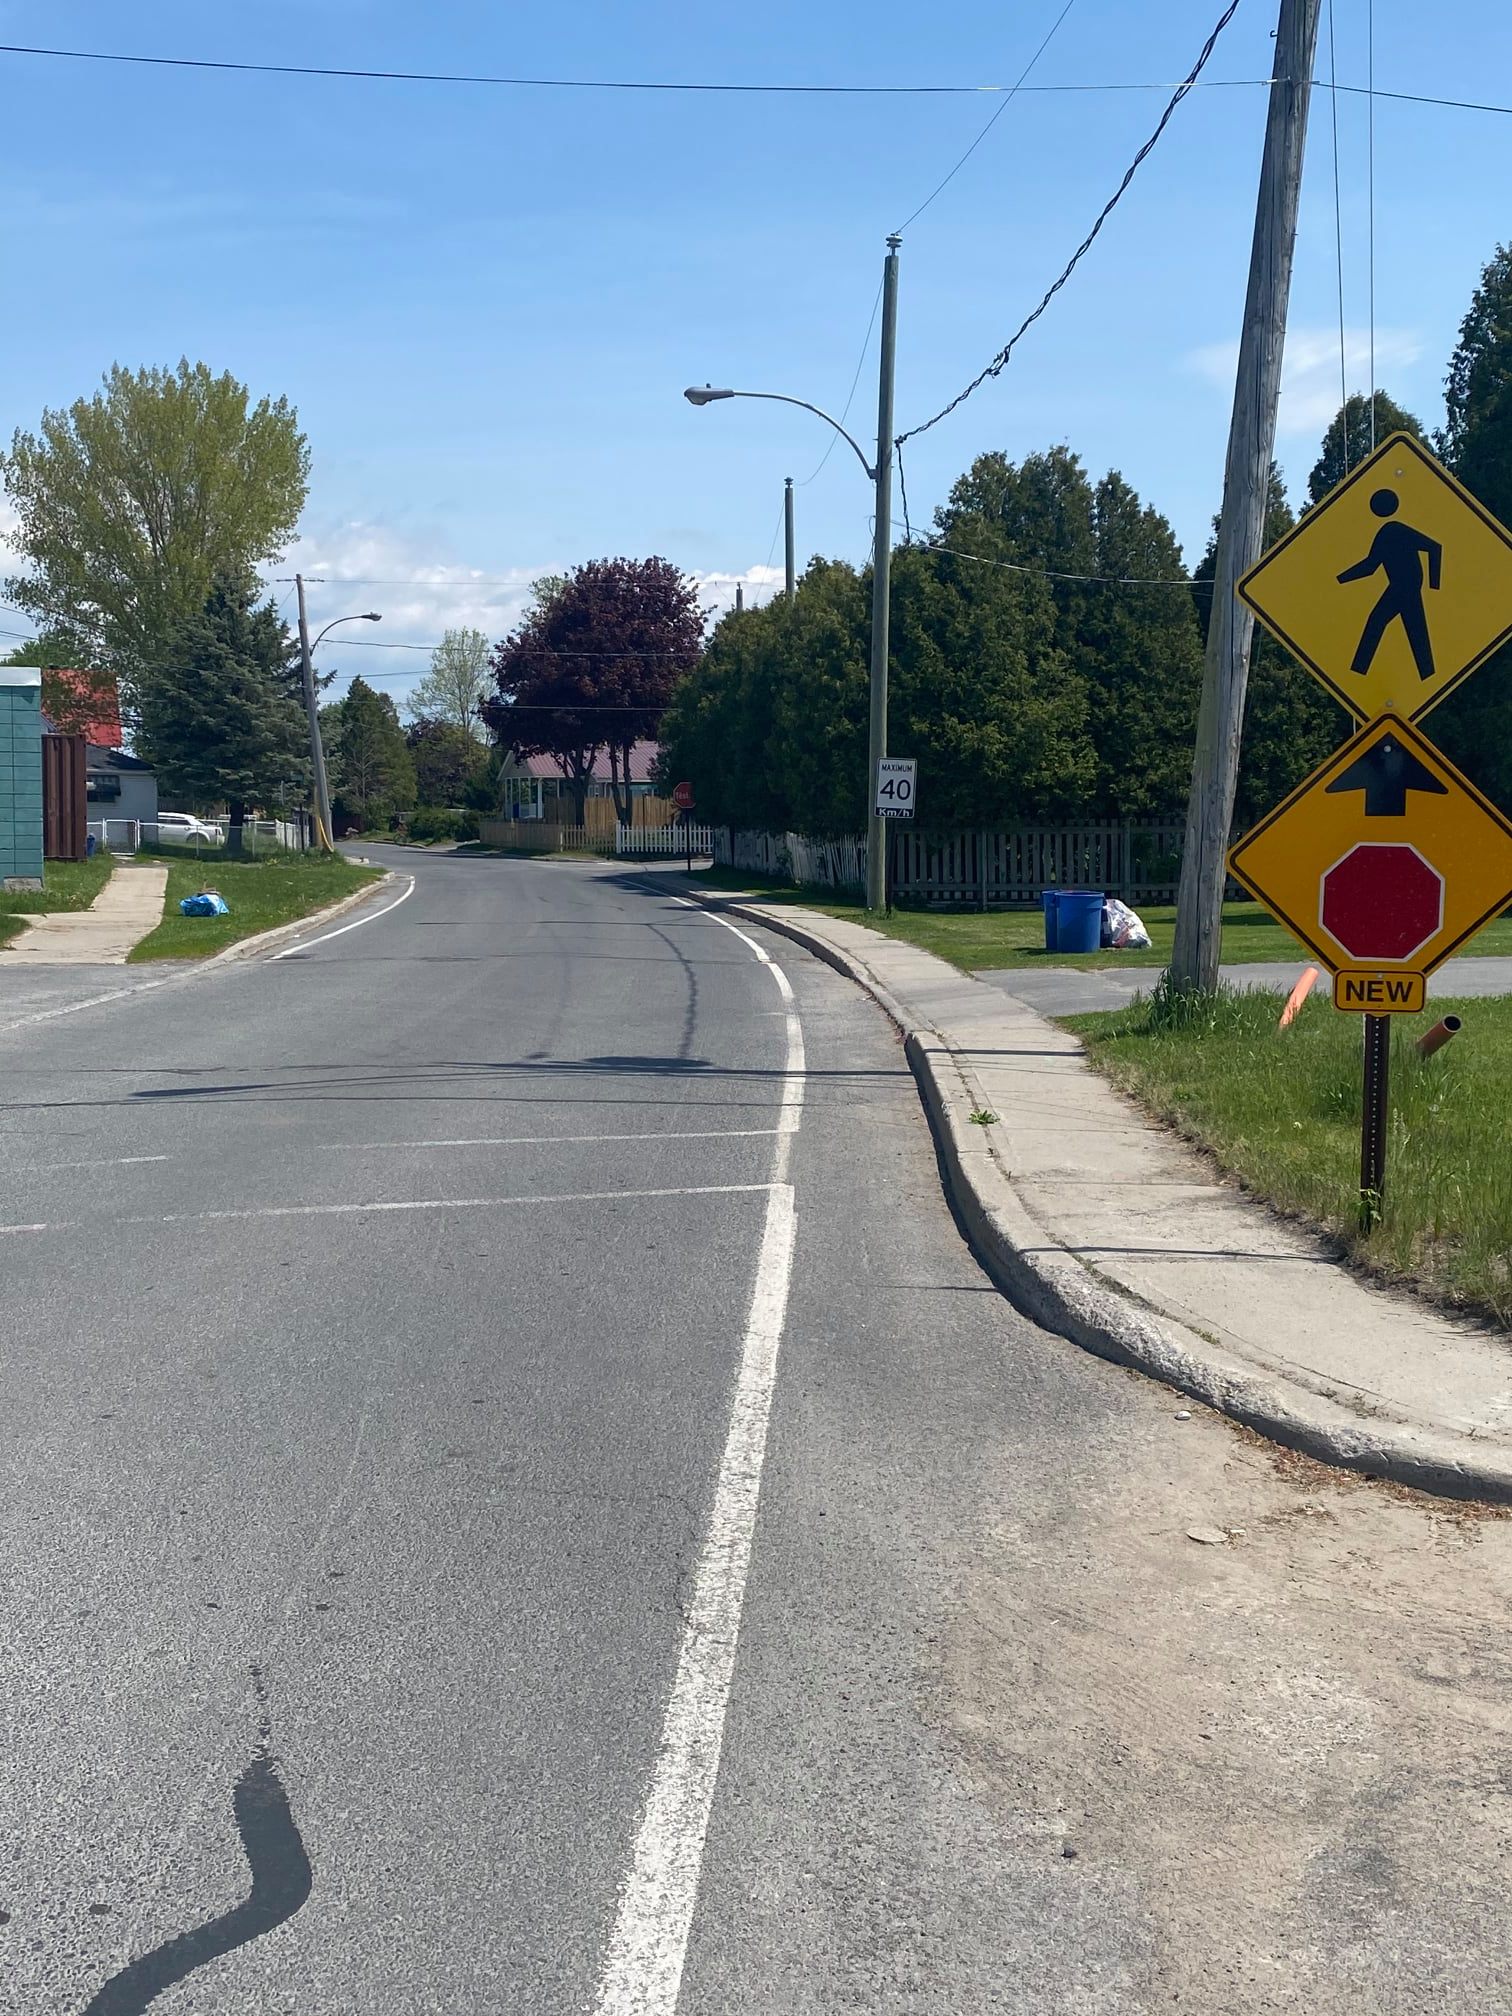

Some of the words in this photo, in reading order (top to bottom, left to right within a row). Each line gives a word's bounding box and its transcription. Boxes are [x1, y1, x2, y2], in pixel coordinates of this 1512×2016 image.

[880, 779, 911, 800] 40
[879, 808, 910, 817] Km/h
[1346, 980, 1413, 1002] NEW
